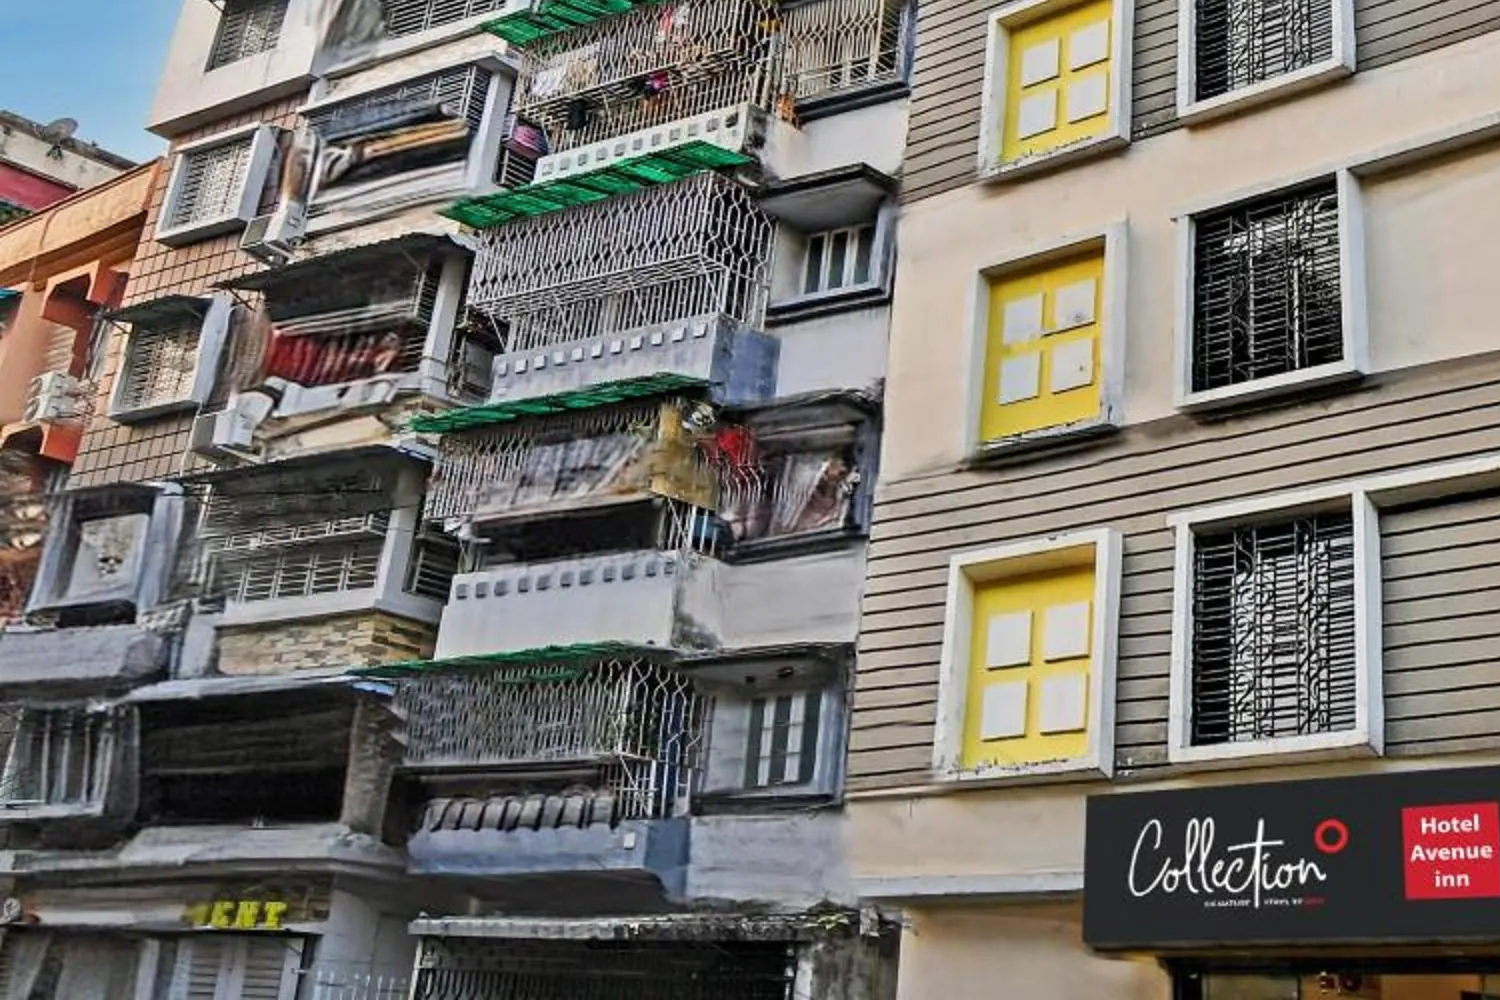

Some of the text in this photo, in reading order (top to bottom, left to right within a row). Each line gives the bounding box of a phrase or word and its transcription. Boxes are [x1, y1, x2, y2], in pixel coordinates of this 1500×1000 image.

[1420, 813, 1480, 835] Hotel
[1129, 816, 1327, 909] Collection
[1410, 844, 1493, 863] Avenue
[1435, 869, 1470, 888] inn
